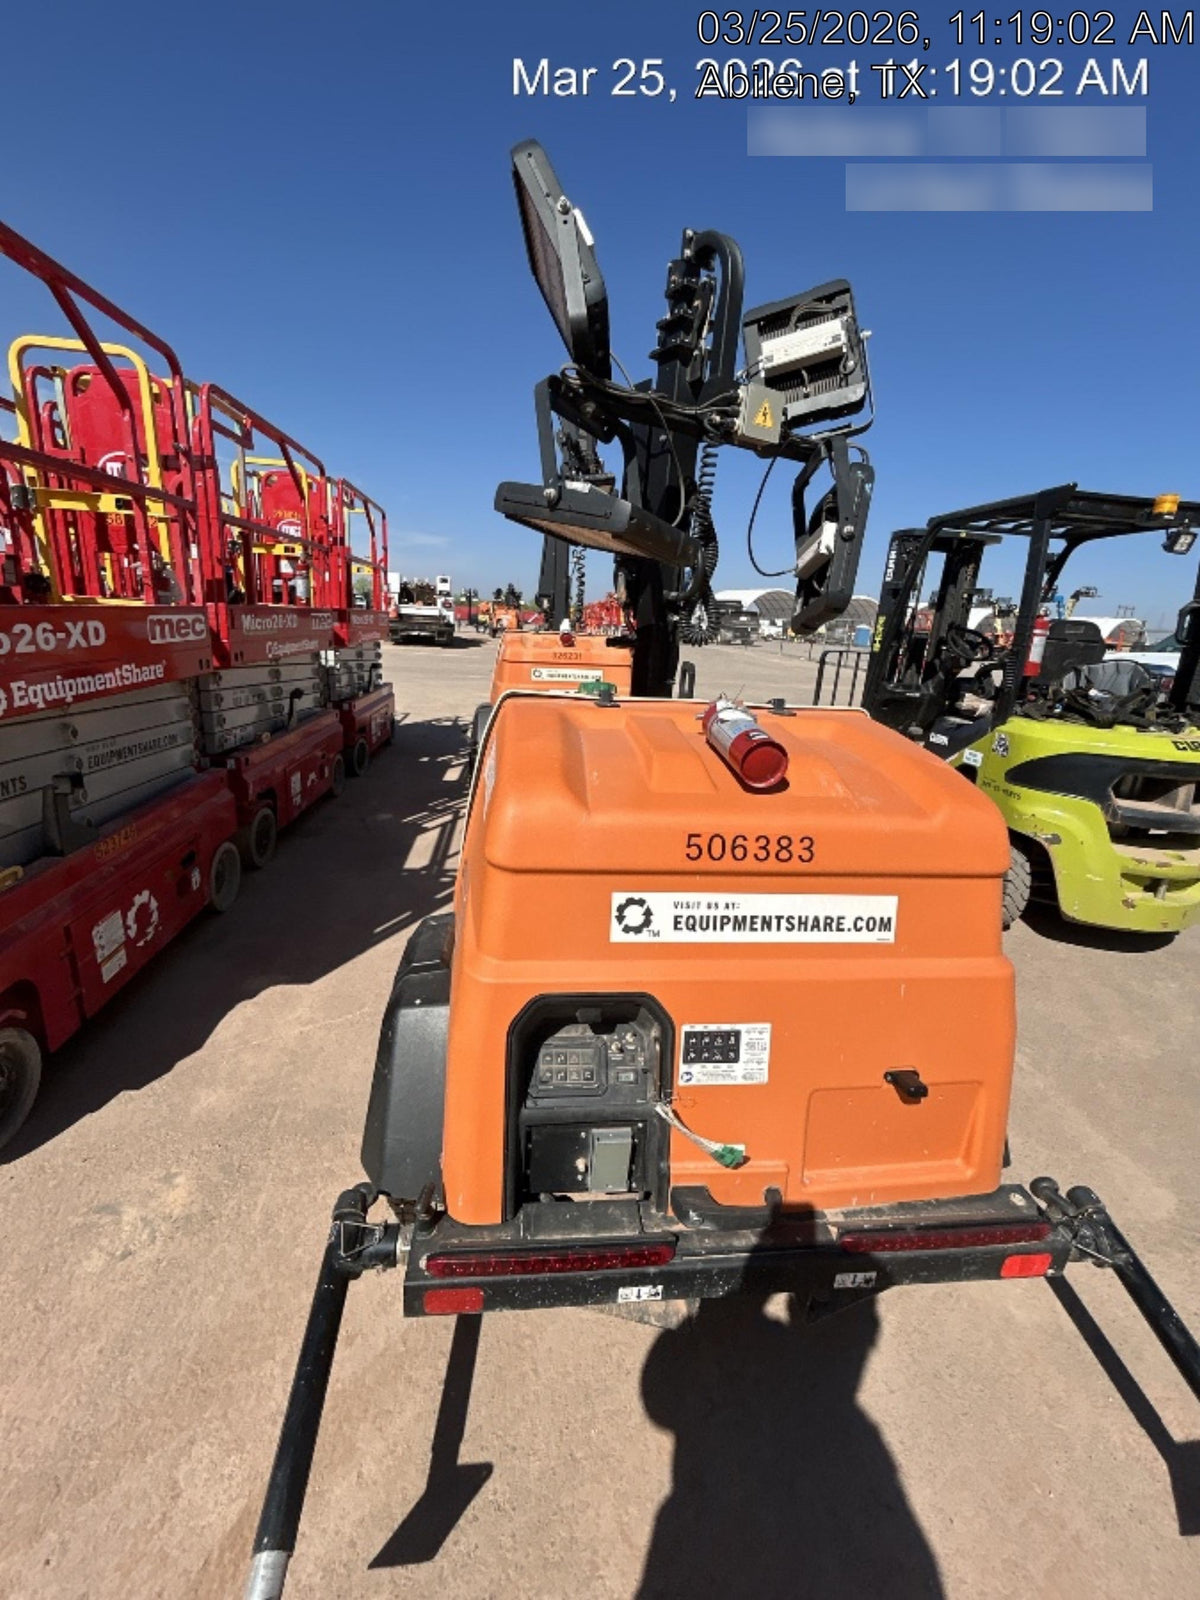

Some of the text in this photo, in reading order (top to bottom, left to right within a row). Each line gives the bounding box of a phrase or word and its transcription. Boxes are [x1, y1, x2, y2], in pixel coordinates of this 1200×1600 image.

[148, 614, 206, 643] mec
[10, 663, 164, 709] EquipmentShare
[685, 833, 815, 862] 506383
[673, 900, 740, 911] VISIT US AT:
[673, 914, 892, 933] EQUIPMENTSHARE.COM
